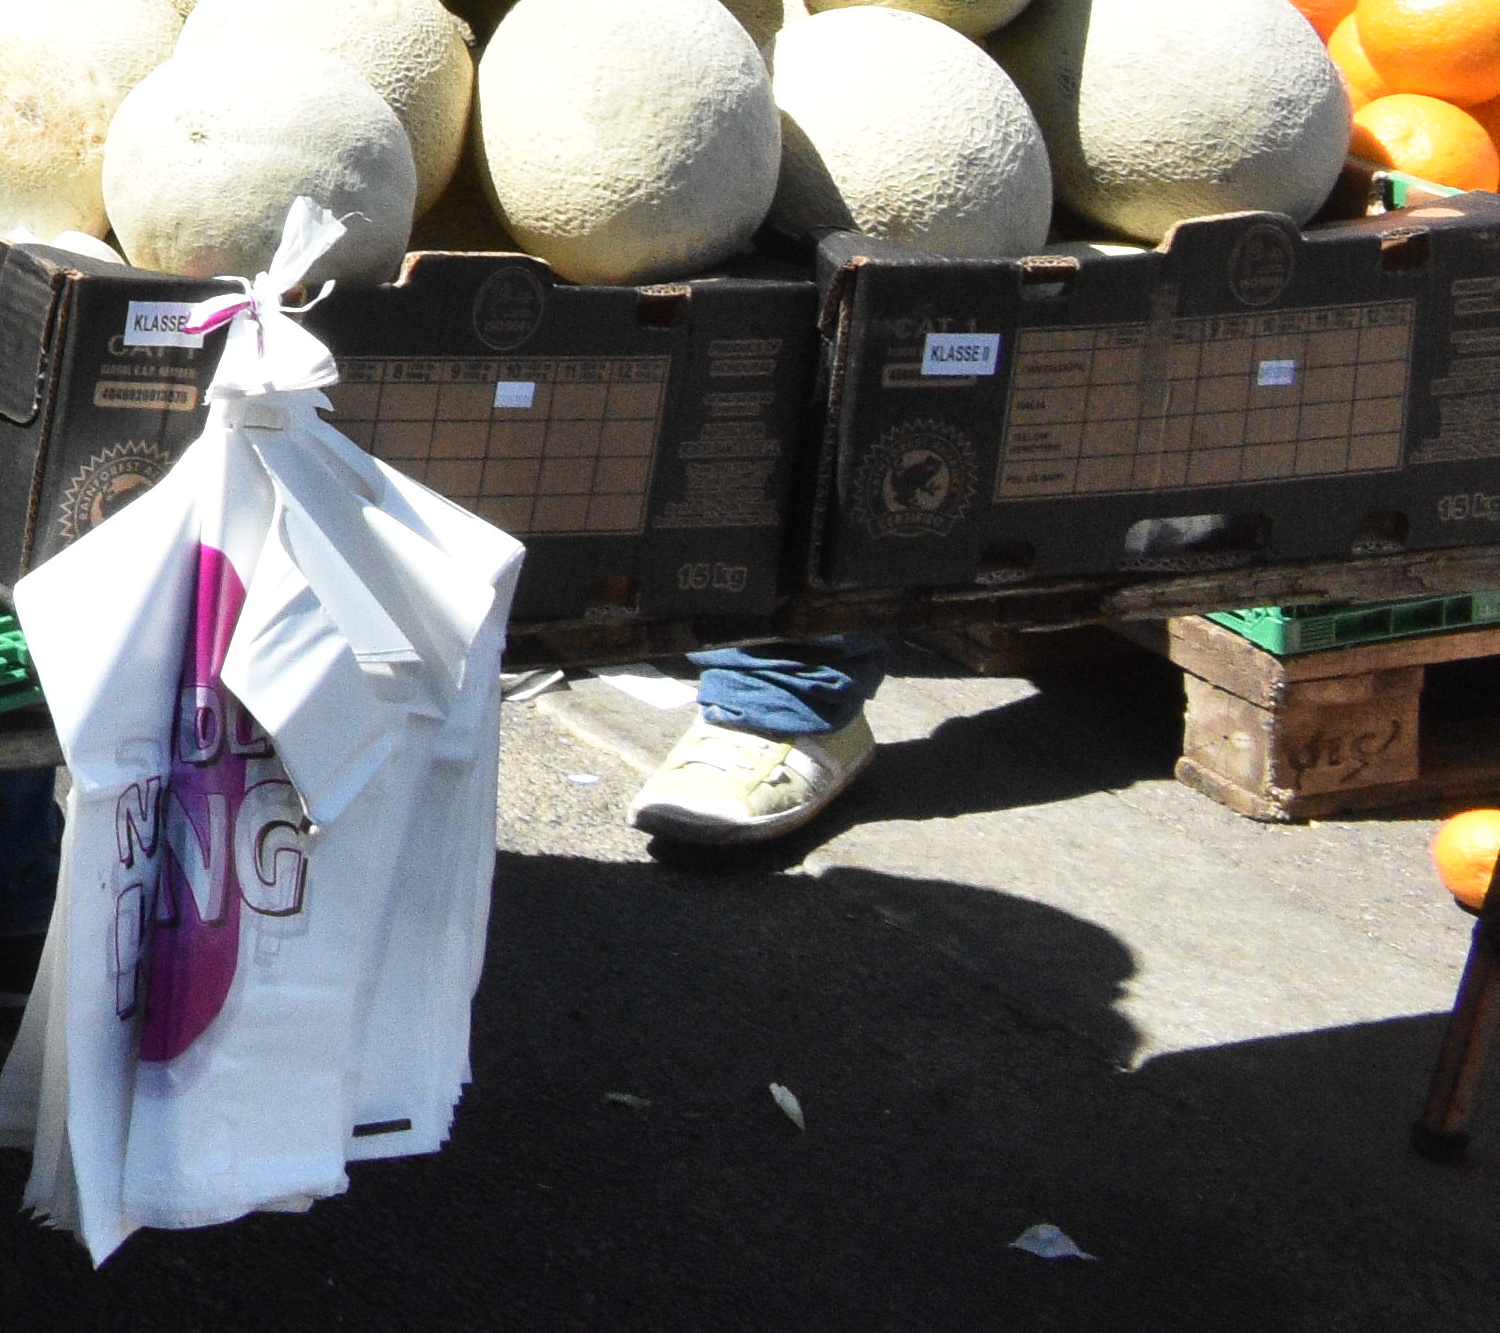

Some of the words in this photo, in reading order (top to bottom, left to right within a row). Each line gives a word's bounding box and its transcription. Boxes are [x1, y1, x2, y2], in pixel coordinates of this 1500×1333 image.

[133, 314, 187, 332] KLASSE
[930, 345, 980, 363] KLASSE
[677, 562, 710, 590] 15
[712, 562, 748, 593] kg
